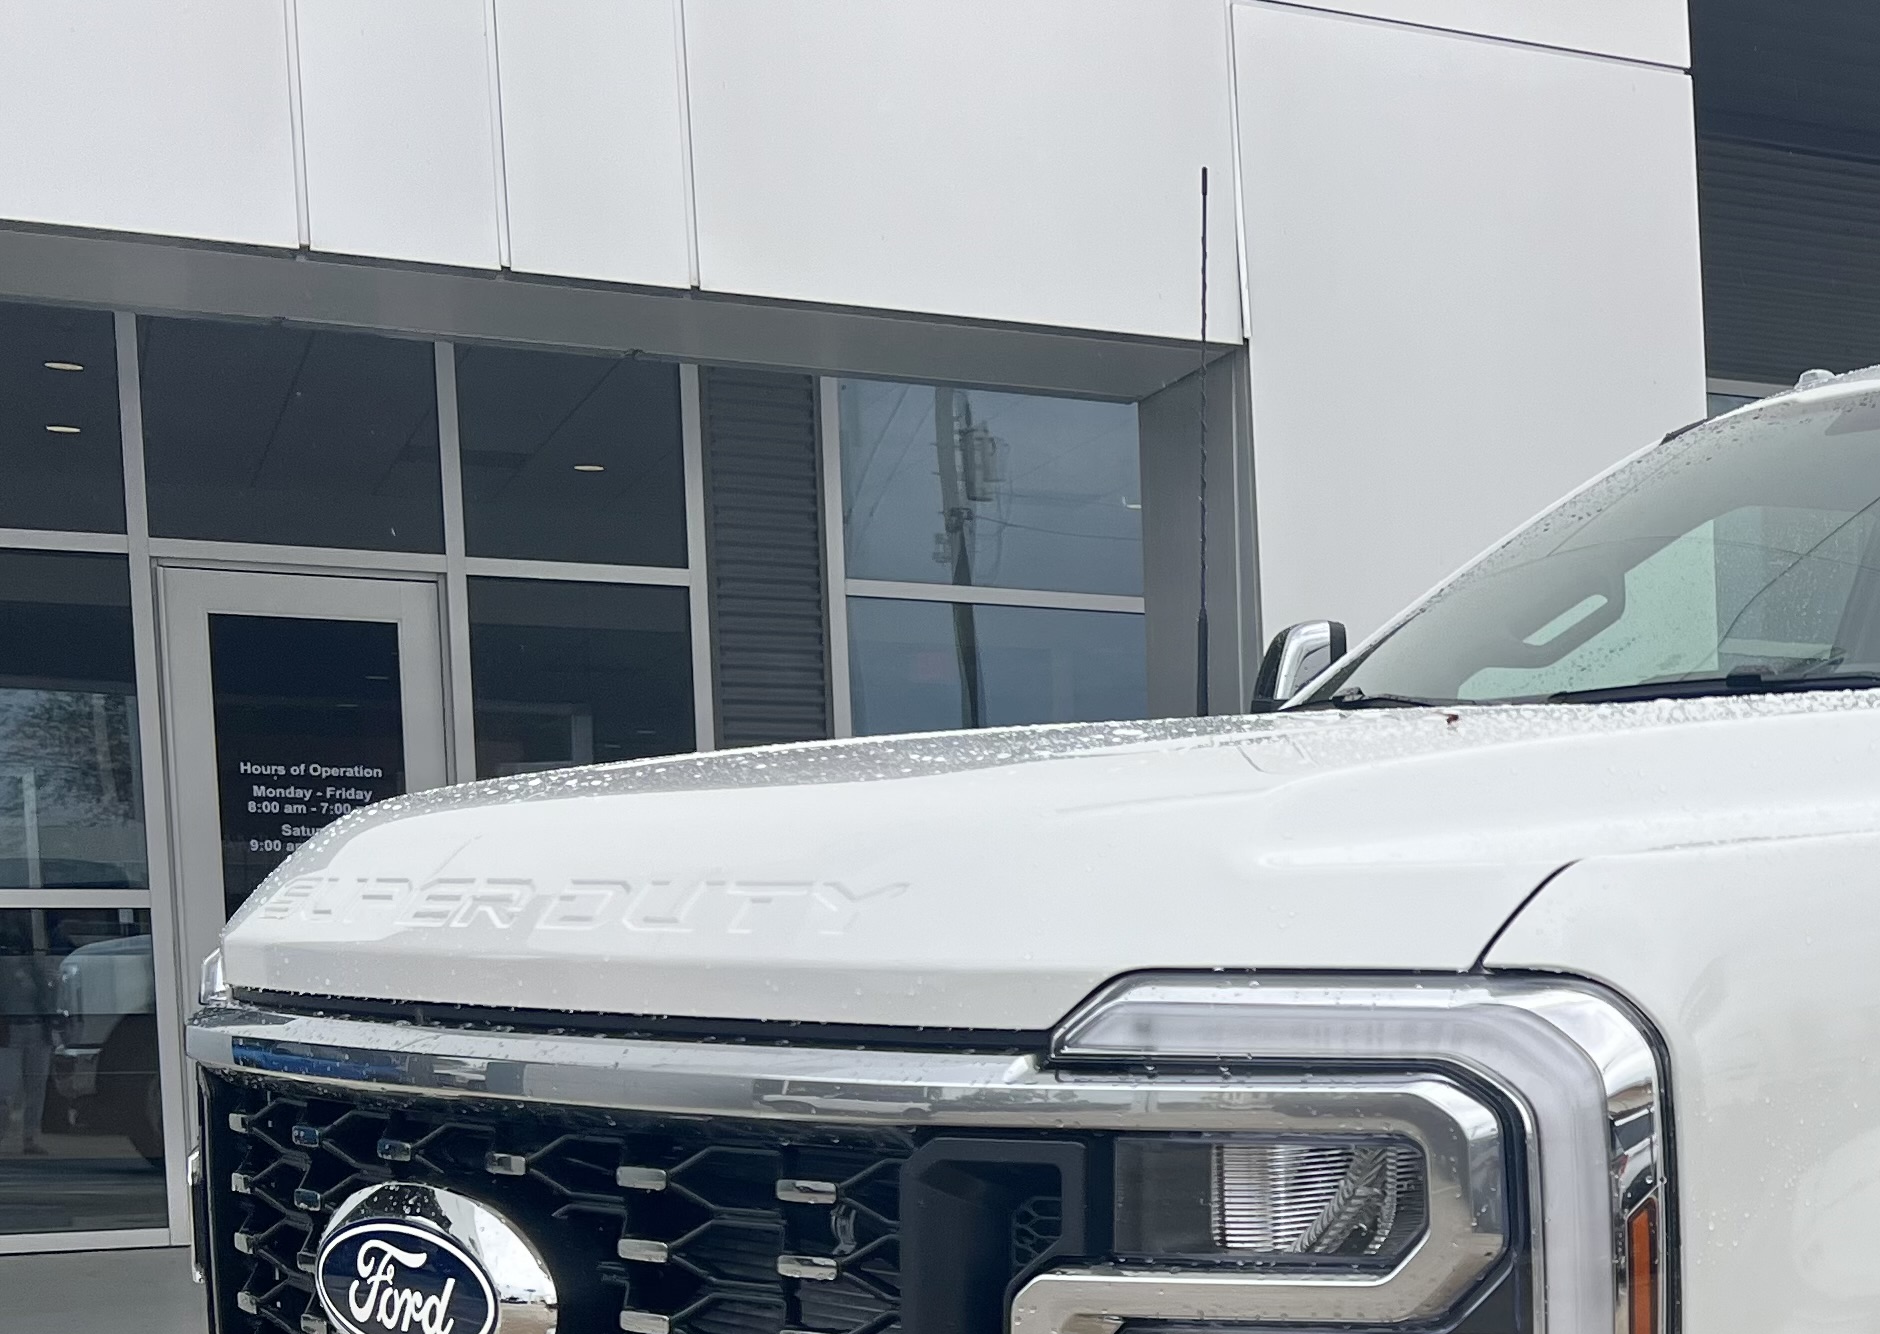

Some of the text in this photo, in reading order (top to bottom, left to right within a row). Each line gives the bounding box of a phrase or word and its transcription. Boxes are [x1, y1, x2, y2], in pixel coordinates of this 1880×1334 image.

[240, 762, 382, 778] Hours of Operation
[253, 785, 312, 800] Monday
[326, 787, 372, 802] Friday
[248, 801, 280, 813] 8:00
[284, 804, 307, 814] am
[321, 803, 351, 815] 7:00
[250, 839, 281, 851] 9:00
[260, 877, 911, 934] SUPER DUTY
